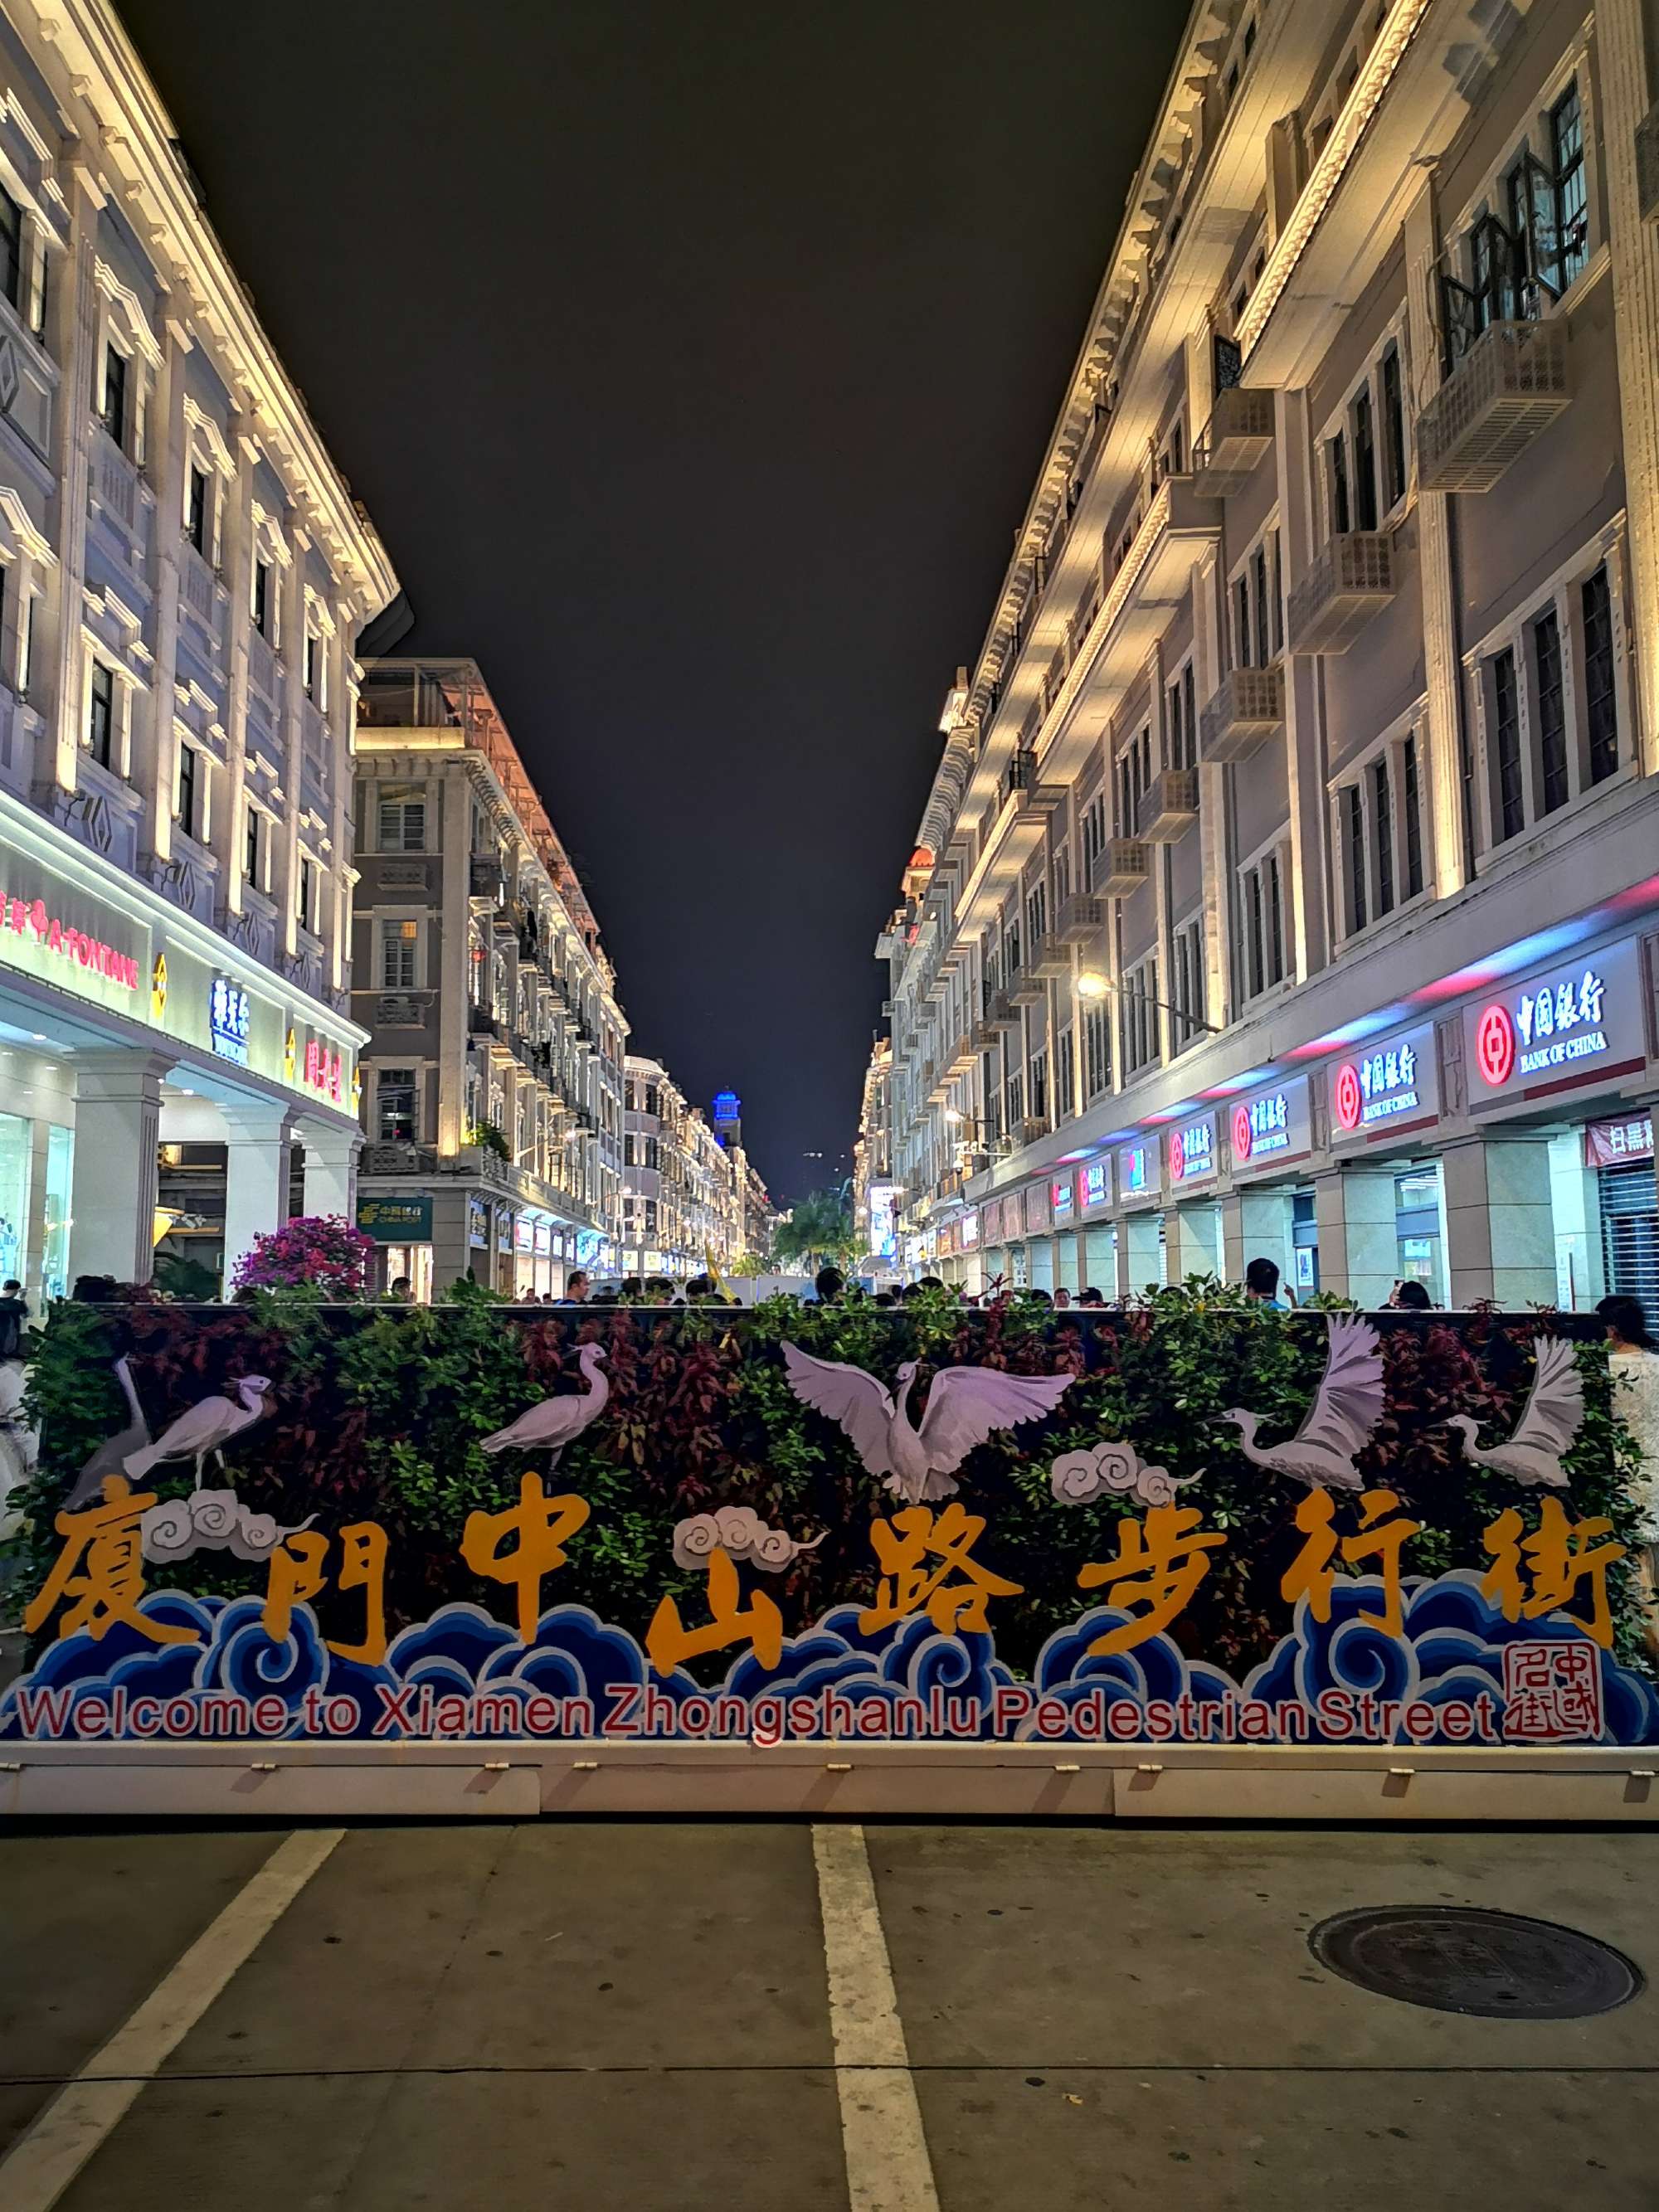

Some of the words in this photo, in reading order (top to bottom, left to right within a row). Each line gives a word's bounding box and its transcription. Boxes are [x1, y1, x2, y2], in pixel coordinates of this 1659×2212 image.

[1516, 970, 1604, 1046] 中国银行
[1360, 1044, 1415, 1099] 中国银行
[1520, 1048, 1550, 1073] BANK
[1550, 1043, 1566, 1063] OF
[1565, 1031, 1607, 1058] CHINA
[17, 1689, 285, 1734] Welcome
[306, 1694, 358, 1733] to
[376, 1689, 591, 1733] Xiamen
[605, 1687, 977, 1745] Zhongshanlu
[997, 1690, 1306, 1737] Pedestrian
[1320, 1692, 1494, 1737] Street
